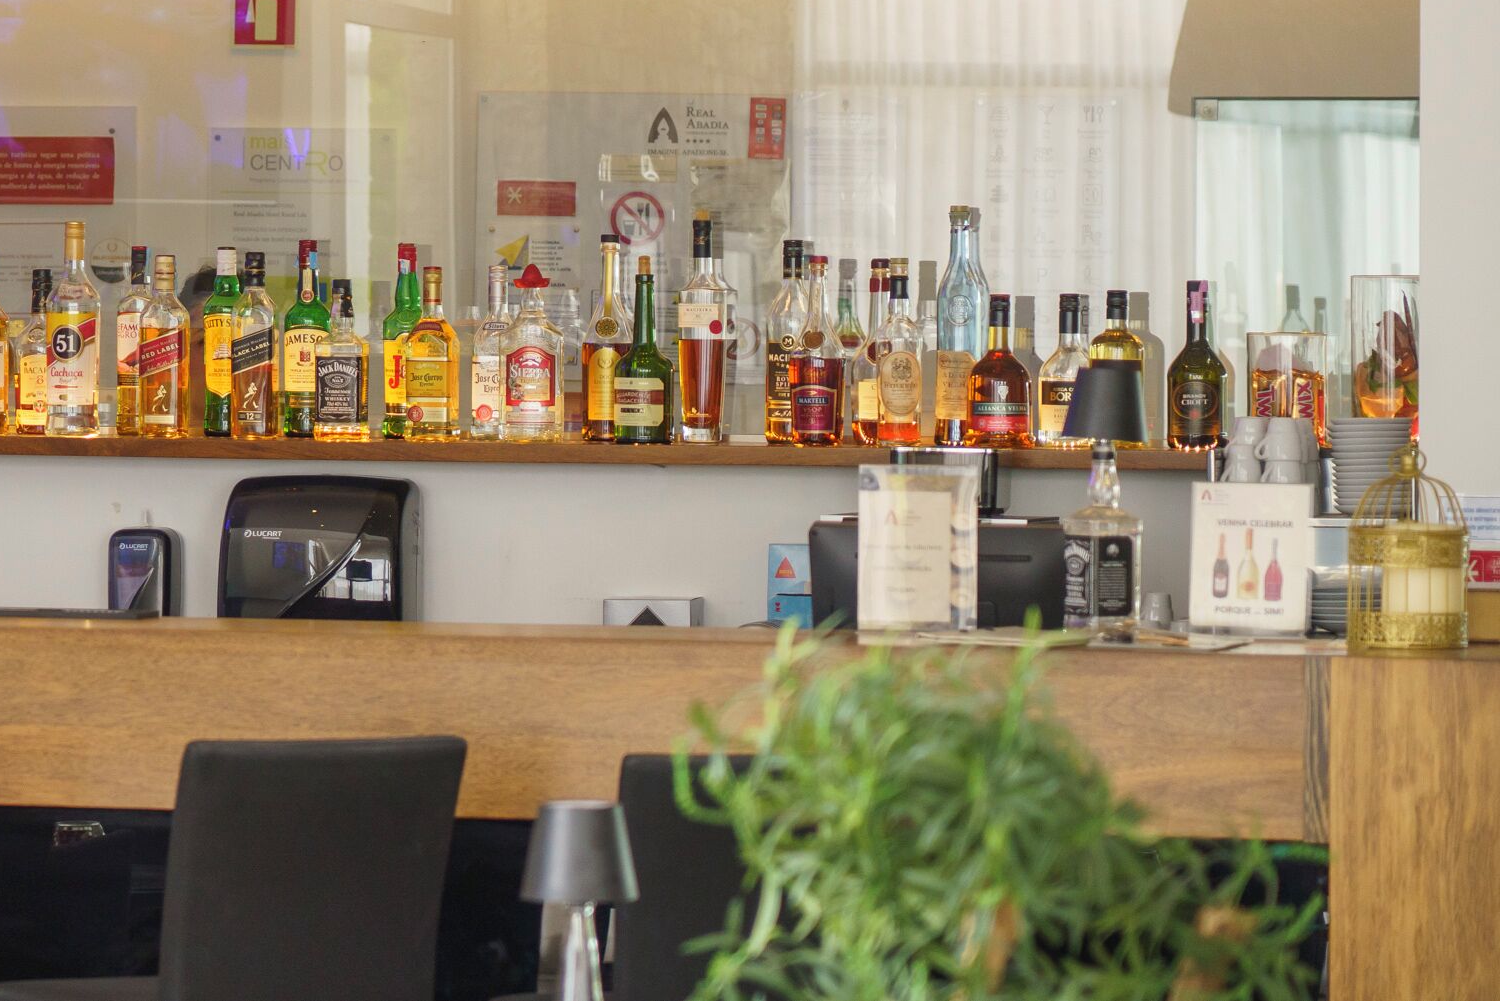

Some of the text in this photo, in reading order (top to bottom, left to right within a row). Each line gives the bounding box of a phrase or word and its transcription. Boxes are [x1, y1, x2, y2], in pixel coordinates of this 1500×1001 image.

[686, 106, 716, 117] REAL
[686, 119, 729, 129] ABADIA
[250, 152, 343, 174] CENTRO
[56, 334, 76, 353] 51
[285, 333, 324, 346] JAMESO
[141, 343, 180, 360] RED LABEL
[250, 341, 270, 352] LABEL
[50, 366, 84, 380] Cachaça
[318, 361, 358, 377] JACK DANIEL'S
[36, 375, 44, 385] 8
[246, 412, 254, 420] 12
